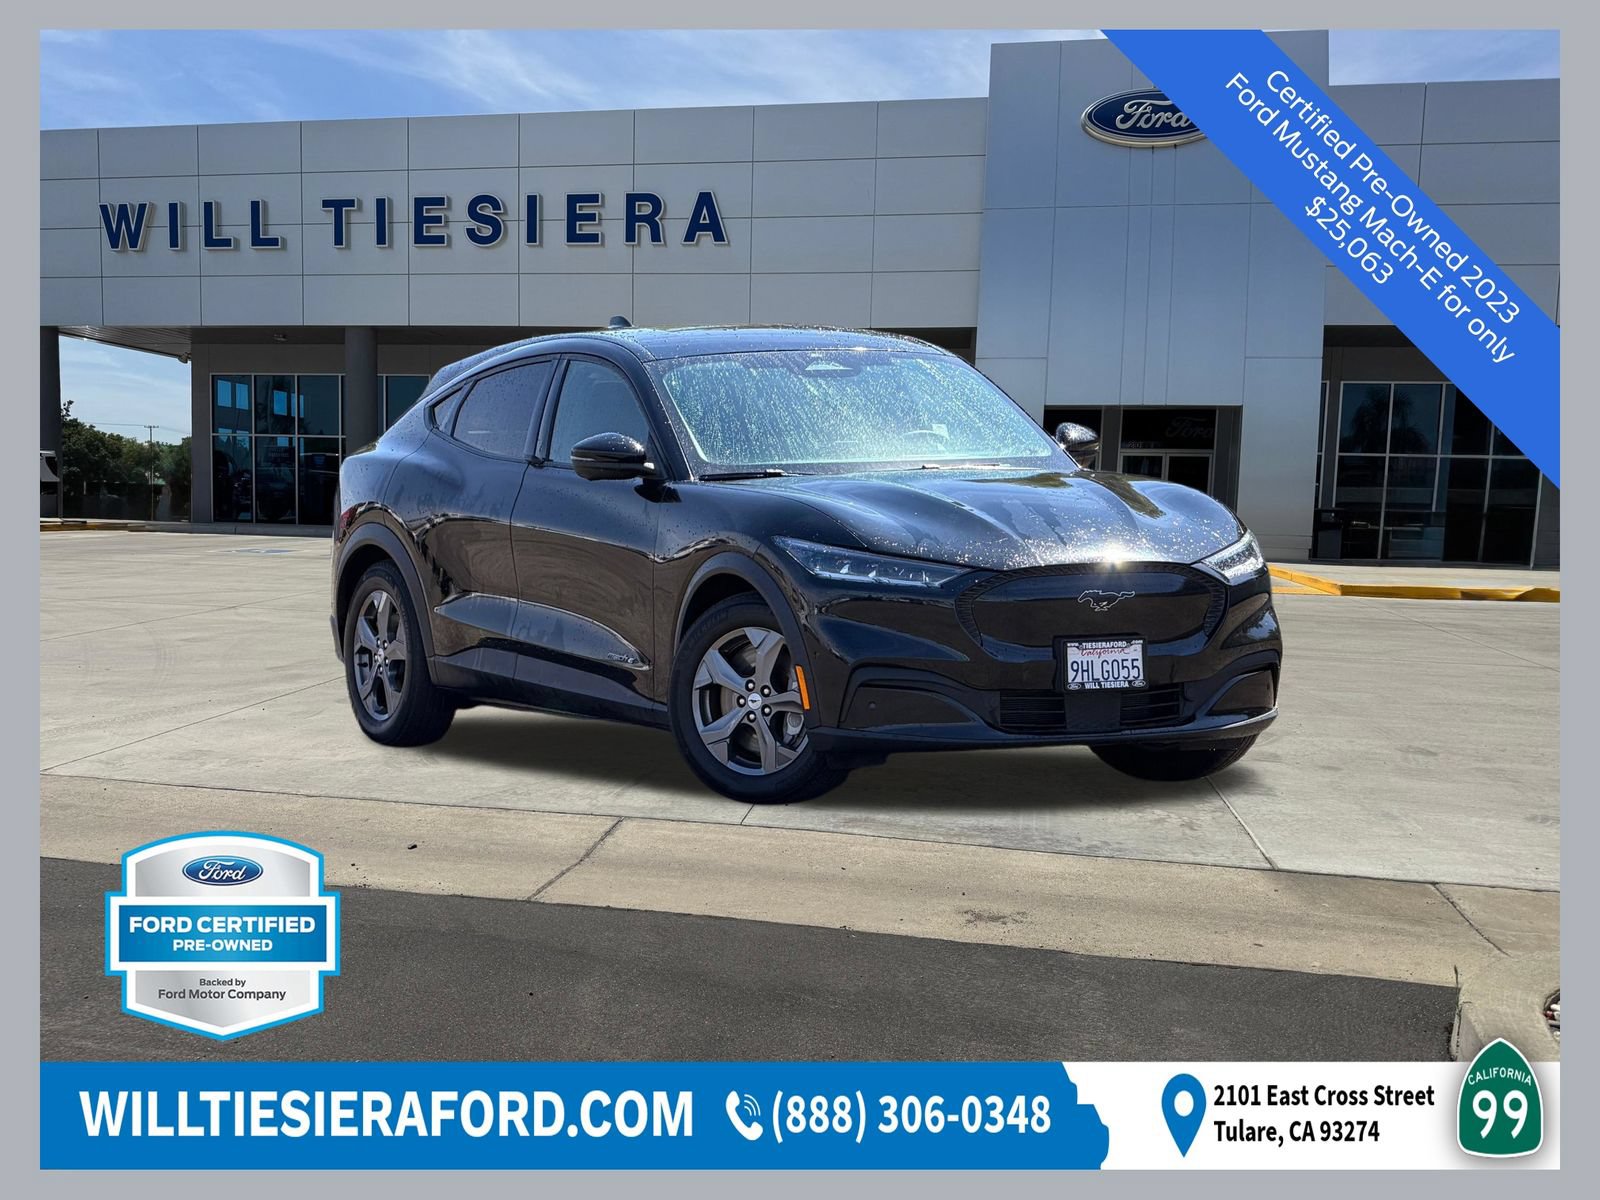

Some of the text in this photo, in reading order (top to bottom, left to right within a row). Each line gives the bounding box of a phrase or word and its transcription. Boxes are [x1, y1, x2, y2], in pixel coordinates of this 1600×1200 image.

[100, 190, 730, 251] WILL TIESIERA
[1082, 641, 1127, 649] TIESIERAFORD
[1070, 658, 1141, 682] 9HLG055
[1101, 681, 1129, 689] TIESIERA
